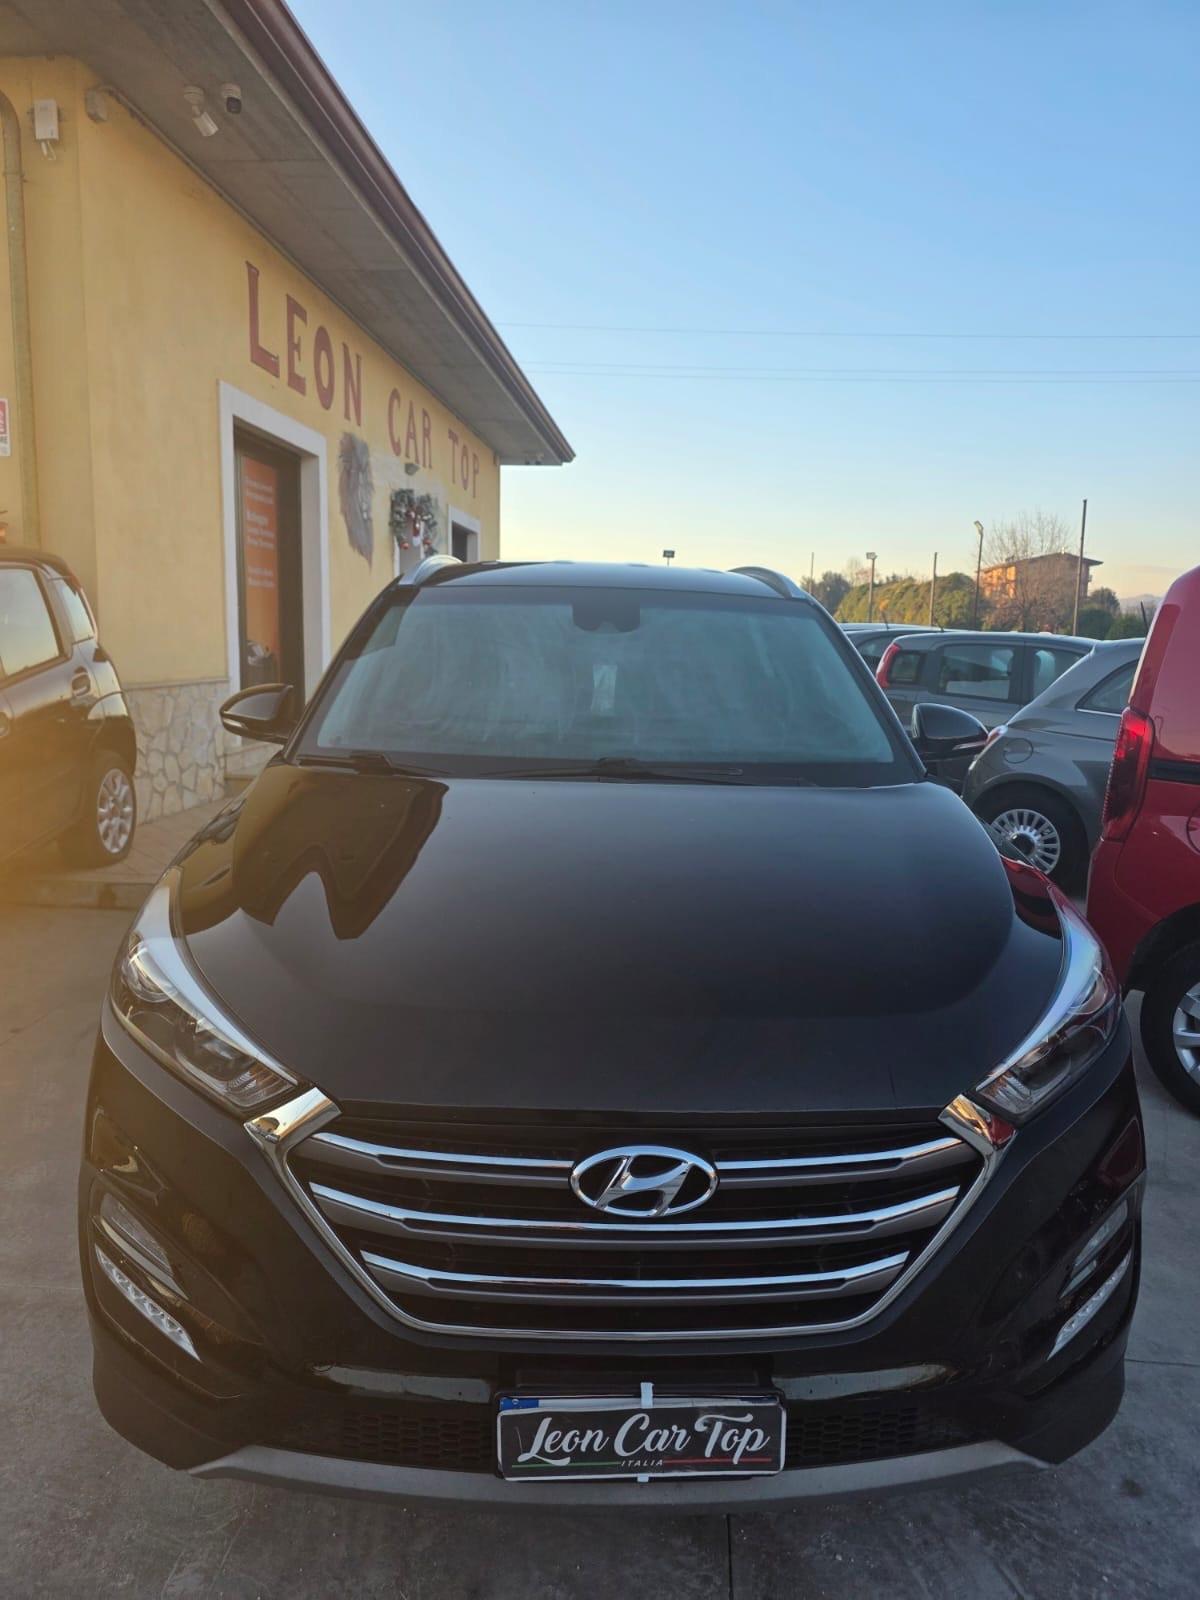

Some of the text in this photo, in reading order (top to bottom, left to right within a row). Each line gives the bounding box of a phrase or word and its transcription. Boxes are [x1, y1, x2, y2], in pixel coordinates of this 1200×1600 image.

[245, 260, 480, 498] LEON CAR TOP
[517, 1413, 770, 1467] Leon Car Top
[620, 1459, 664, 1468] ITALIA
